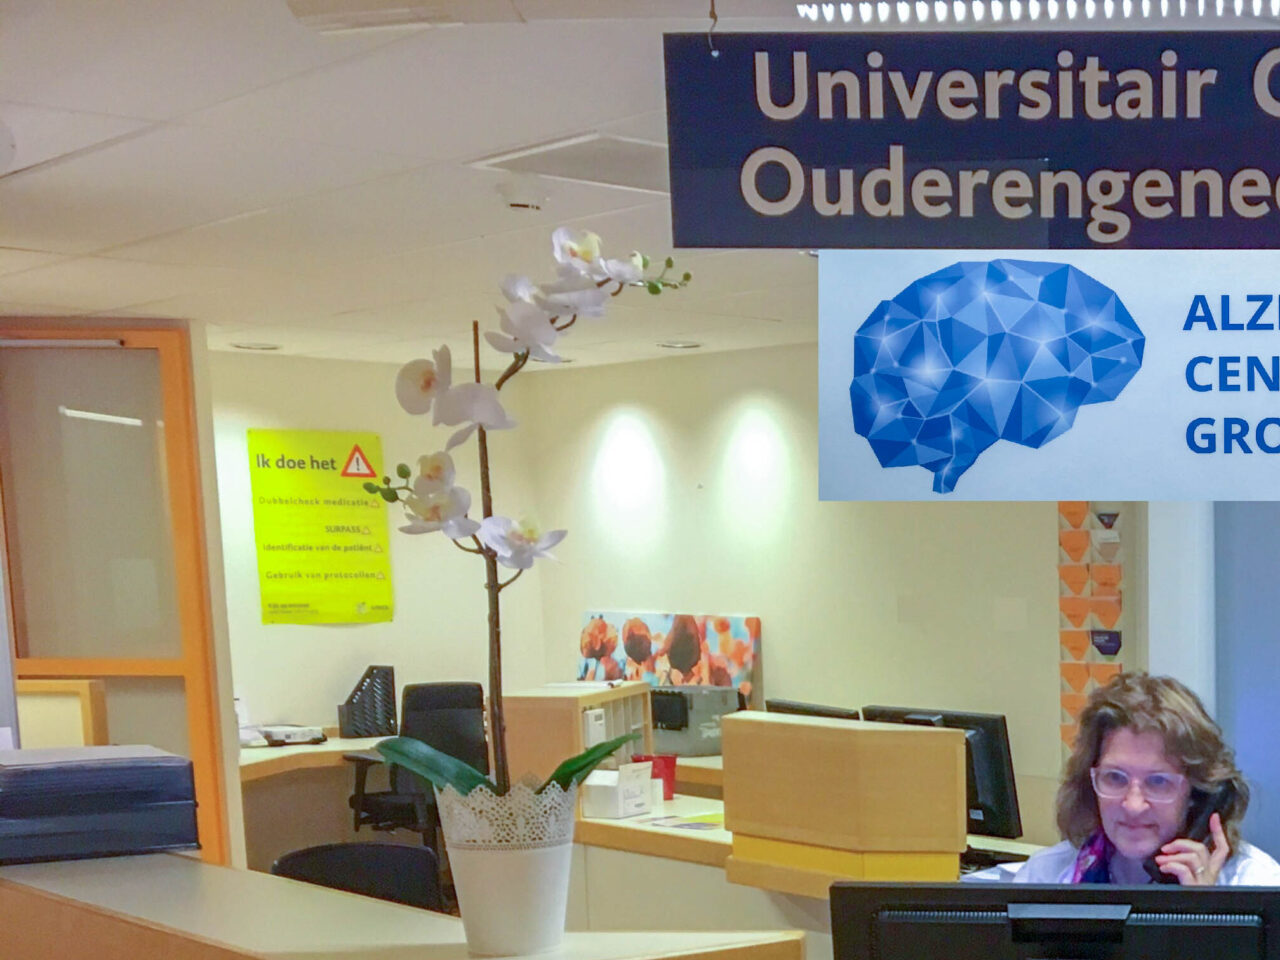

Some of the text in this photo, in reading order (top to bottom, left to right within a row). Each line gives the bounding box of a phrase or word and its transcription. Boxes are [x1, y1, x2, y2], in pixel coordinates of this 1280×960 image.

[754, 50, 1219, 121] Universitair
[256, 453, 337, 470] Ik doe het
[325, 525, 361, 533] SURPASS
[263, 543, 313, 552] Identificatie
[331, 543, 341, 552] de
[265, 571, 302, 579] Gebruik
